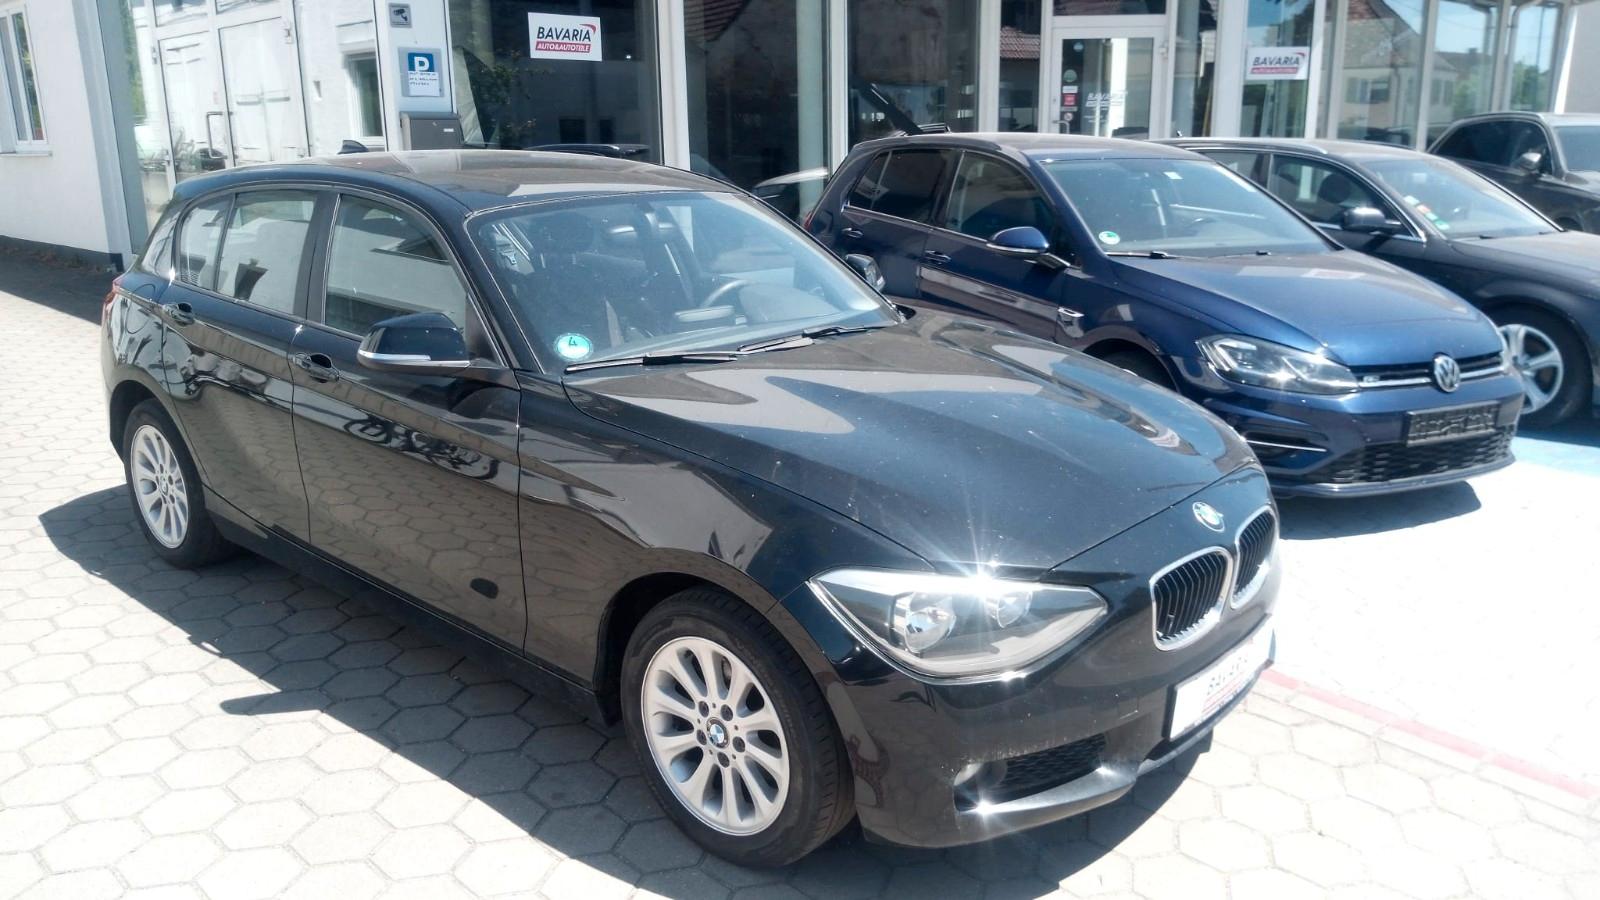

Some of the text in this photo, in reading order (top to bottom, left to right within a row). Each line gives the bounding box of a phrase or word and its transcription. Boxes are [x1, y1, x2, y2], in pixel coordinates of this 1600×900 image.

[537, 26, 591, 42] BAVARIA
[413, 56, 430, 72] P
[1253, 56, 1300, 66] BAVARIA
